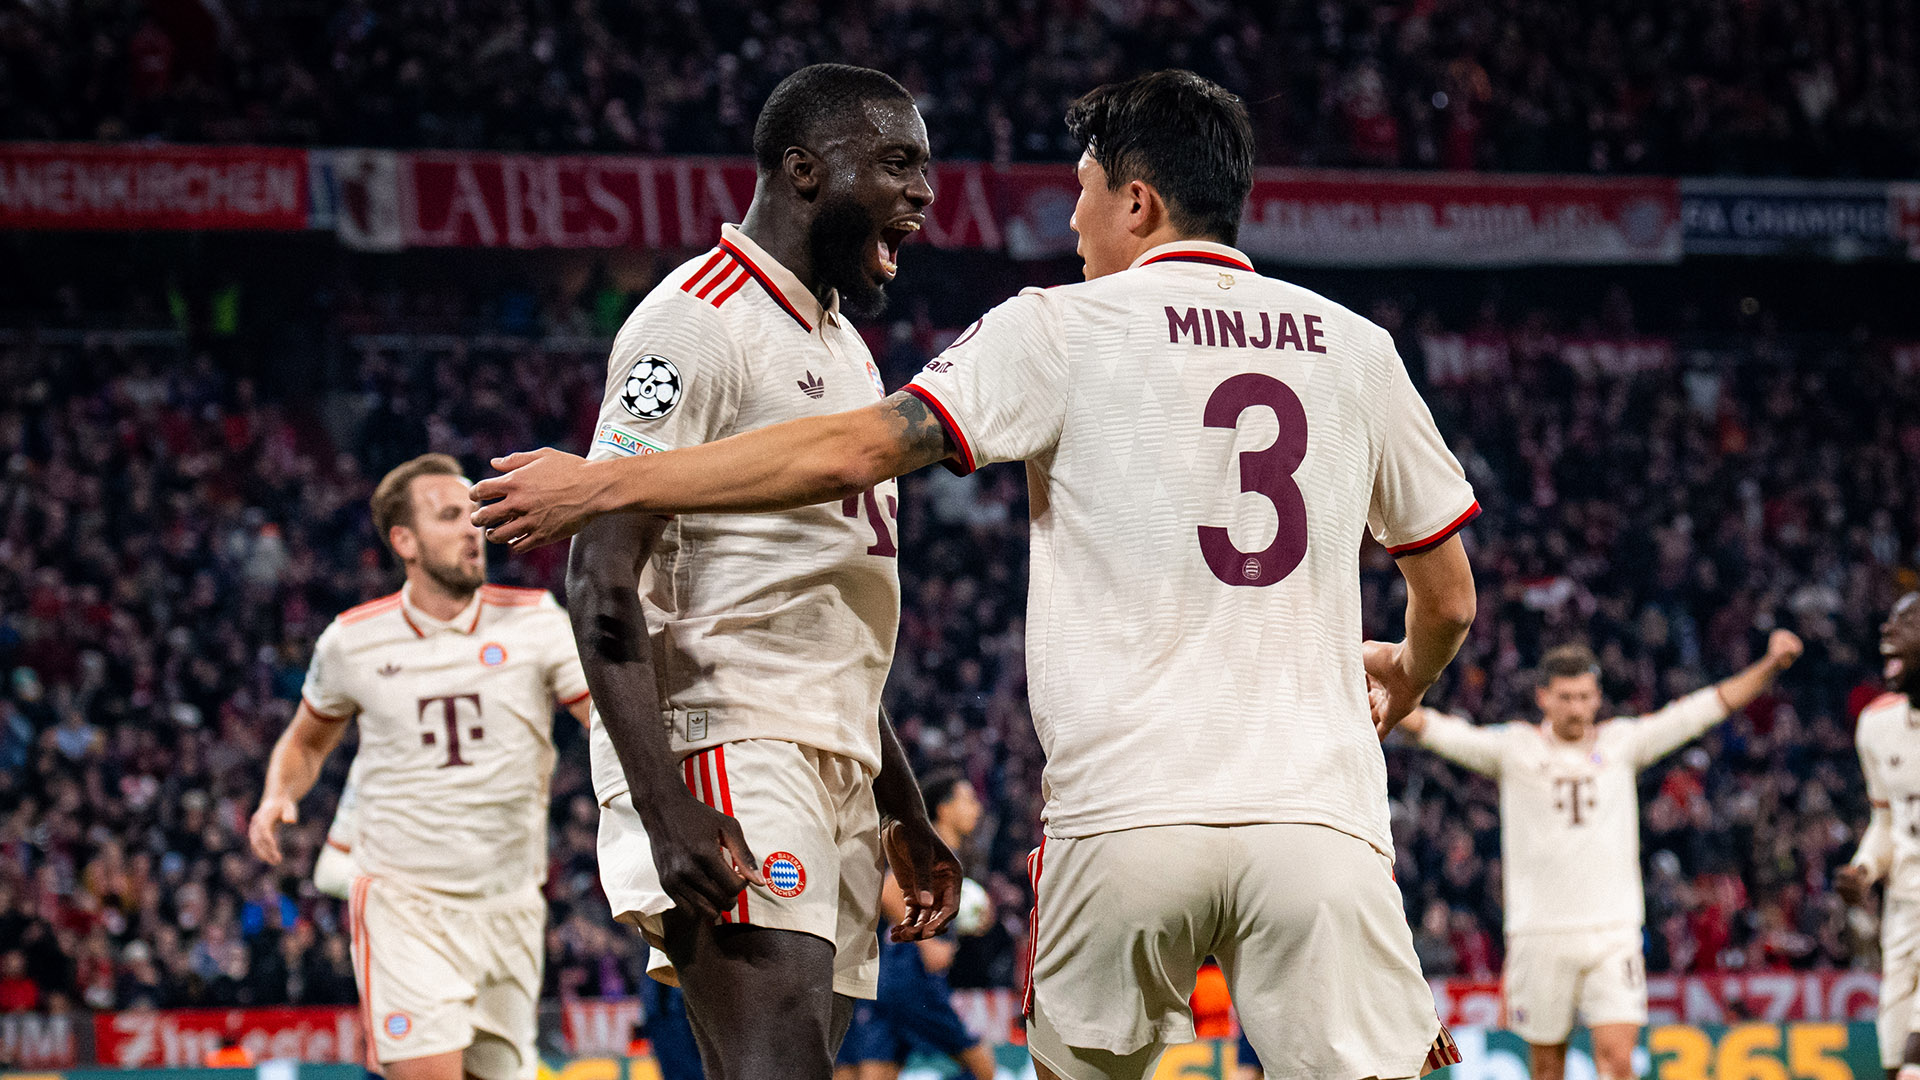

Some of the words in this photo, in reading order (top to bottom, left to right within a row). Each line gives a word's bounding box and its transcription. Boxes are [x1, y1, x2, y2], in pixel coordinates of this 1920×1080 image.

[1164, 306, 1327, 354] MINJAE
[639, 374, 658, 399] 6
[599, 430, 660, 456] FOUNDATIO
[1197, 372, 1308, 587] 3
[418, 693, 484, 769] T
[778, 853, 802, 870] BAYERN
